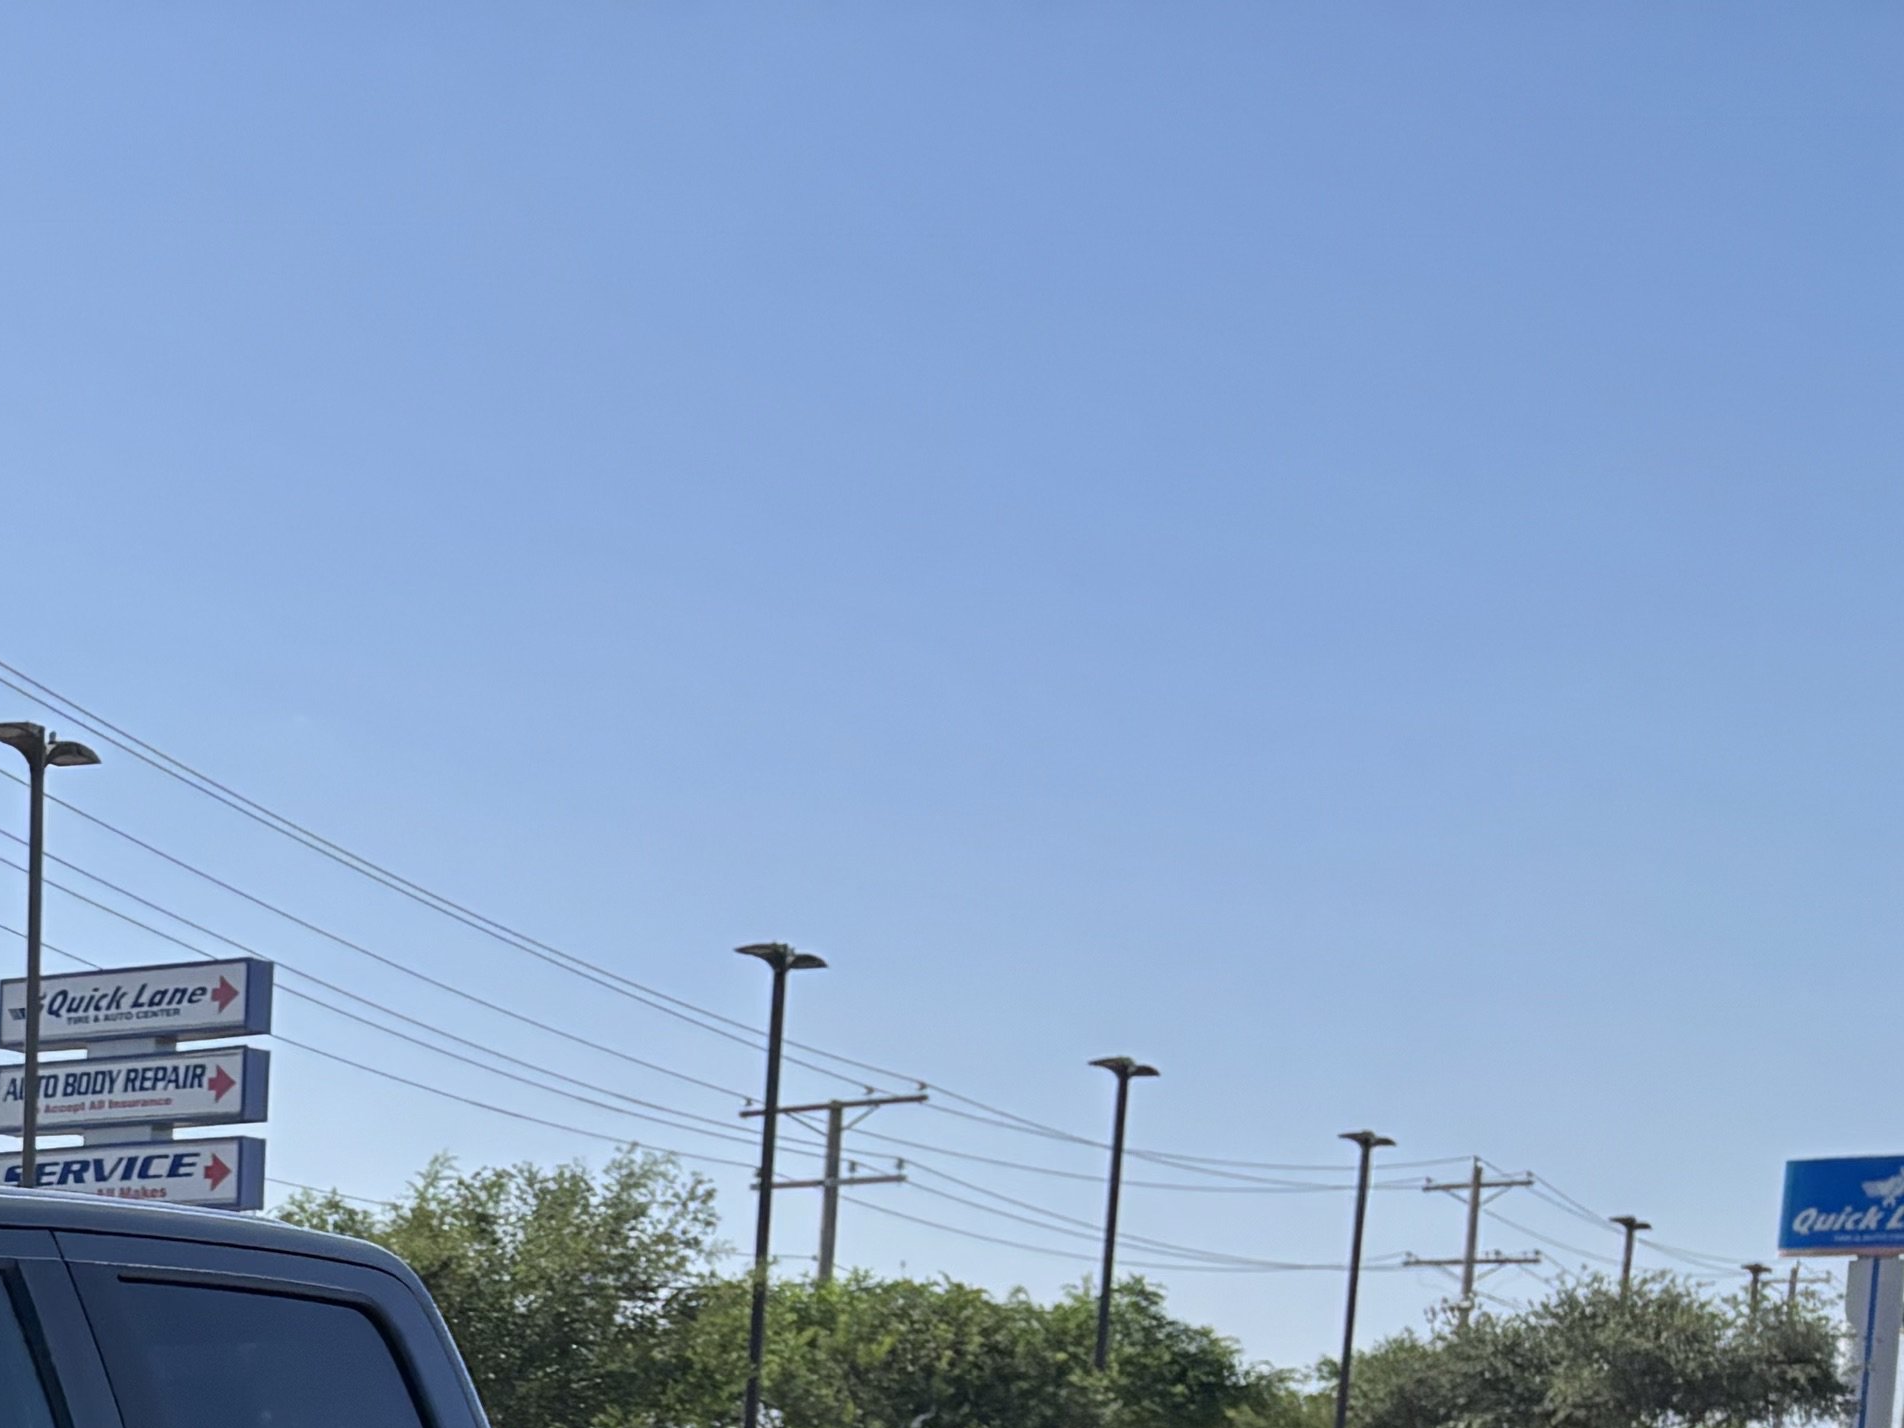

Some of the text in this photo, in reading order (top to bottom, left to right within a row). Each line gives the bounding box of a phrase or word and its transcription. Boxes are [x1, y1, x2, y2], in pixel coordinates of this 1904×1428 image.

[47, 983, 208, 1018] Quick Lane
[66, 1008, 181, 1026] TIRE & AUTO CENTER
[62, 1069, 122, 1098] BODY
[123, 1064, 206, 1093] REPAIR
[44, 1101, 85, 1115] Accept
[108, 1097, 173, 1109] Insurance
[1793, 1205, 1884, 1236] Quick
